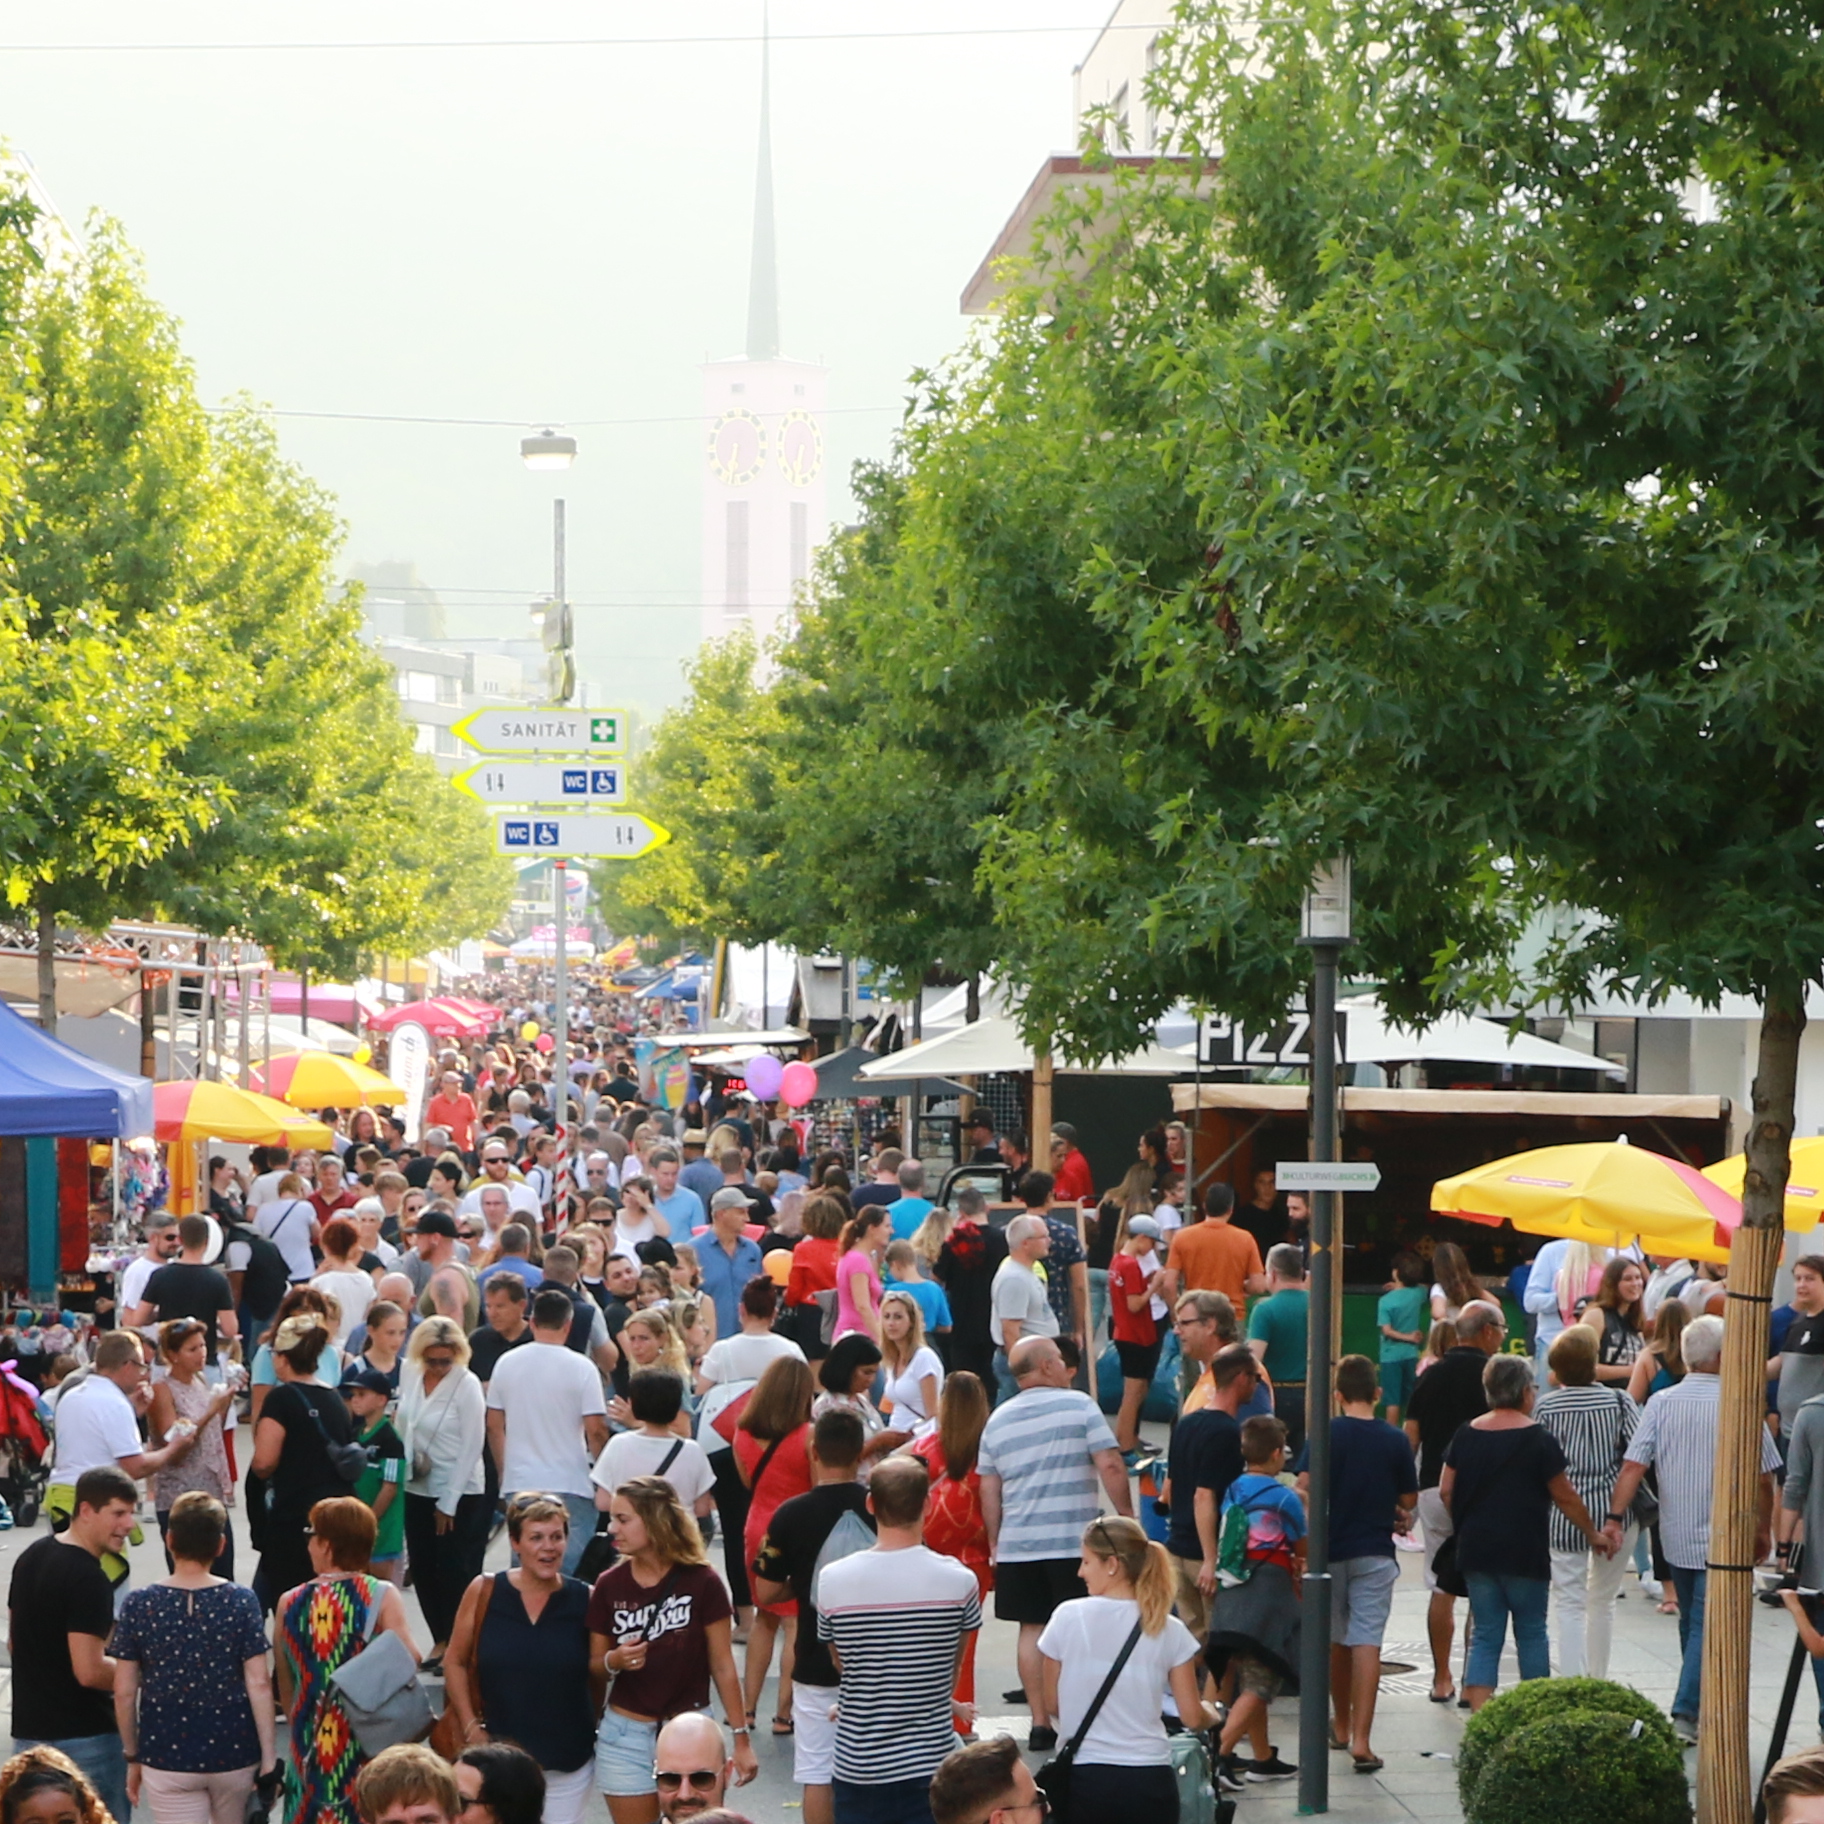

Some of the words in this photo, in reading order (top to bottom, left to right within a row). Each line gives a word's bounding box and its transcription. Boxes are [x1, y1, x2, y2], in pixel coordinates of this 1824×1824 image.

[501, 720, 578, 738] SANITÄT
[564, 774, 586, 789] WC
[507, 826, 528, 841] WC
[1199, 1012, 1343, 1064] PIZZ
